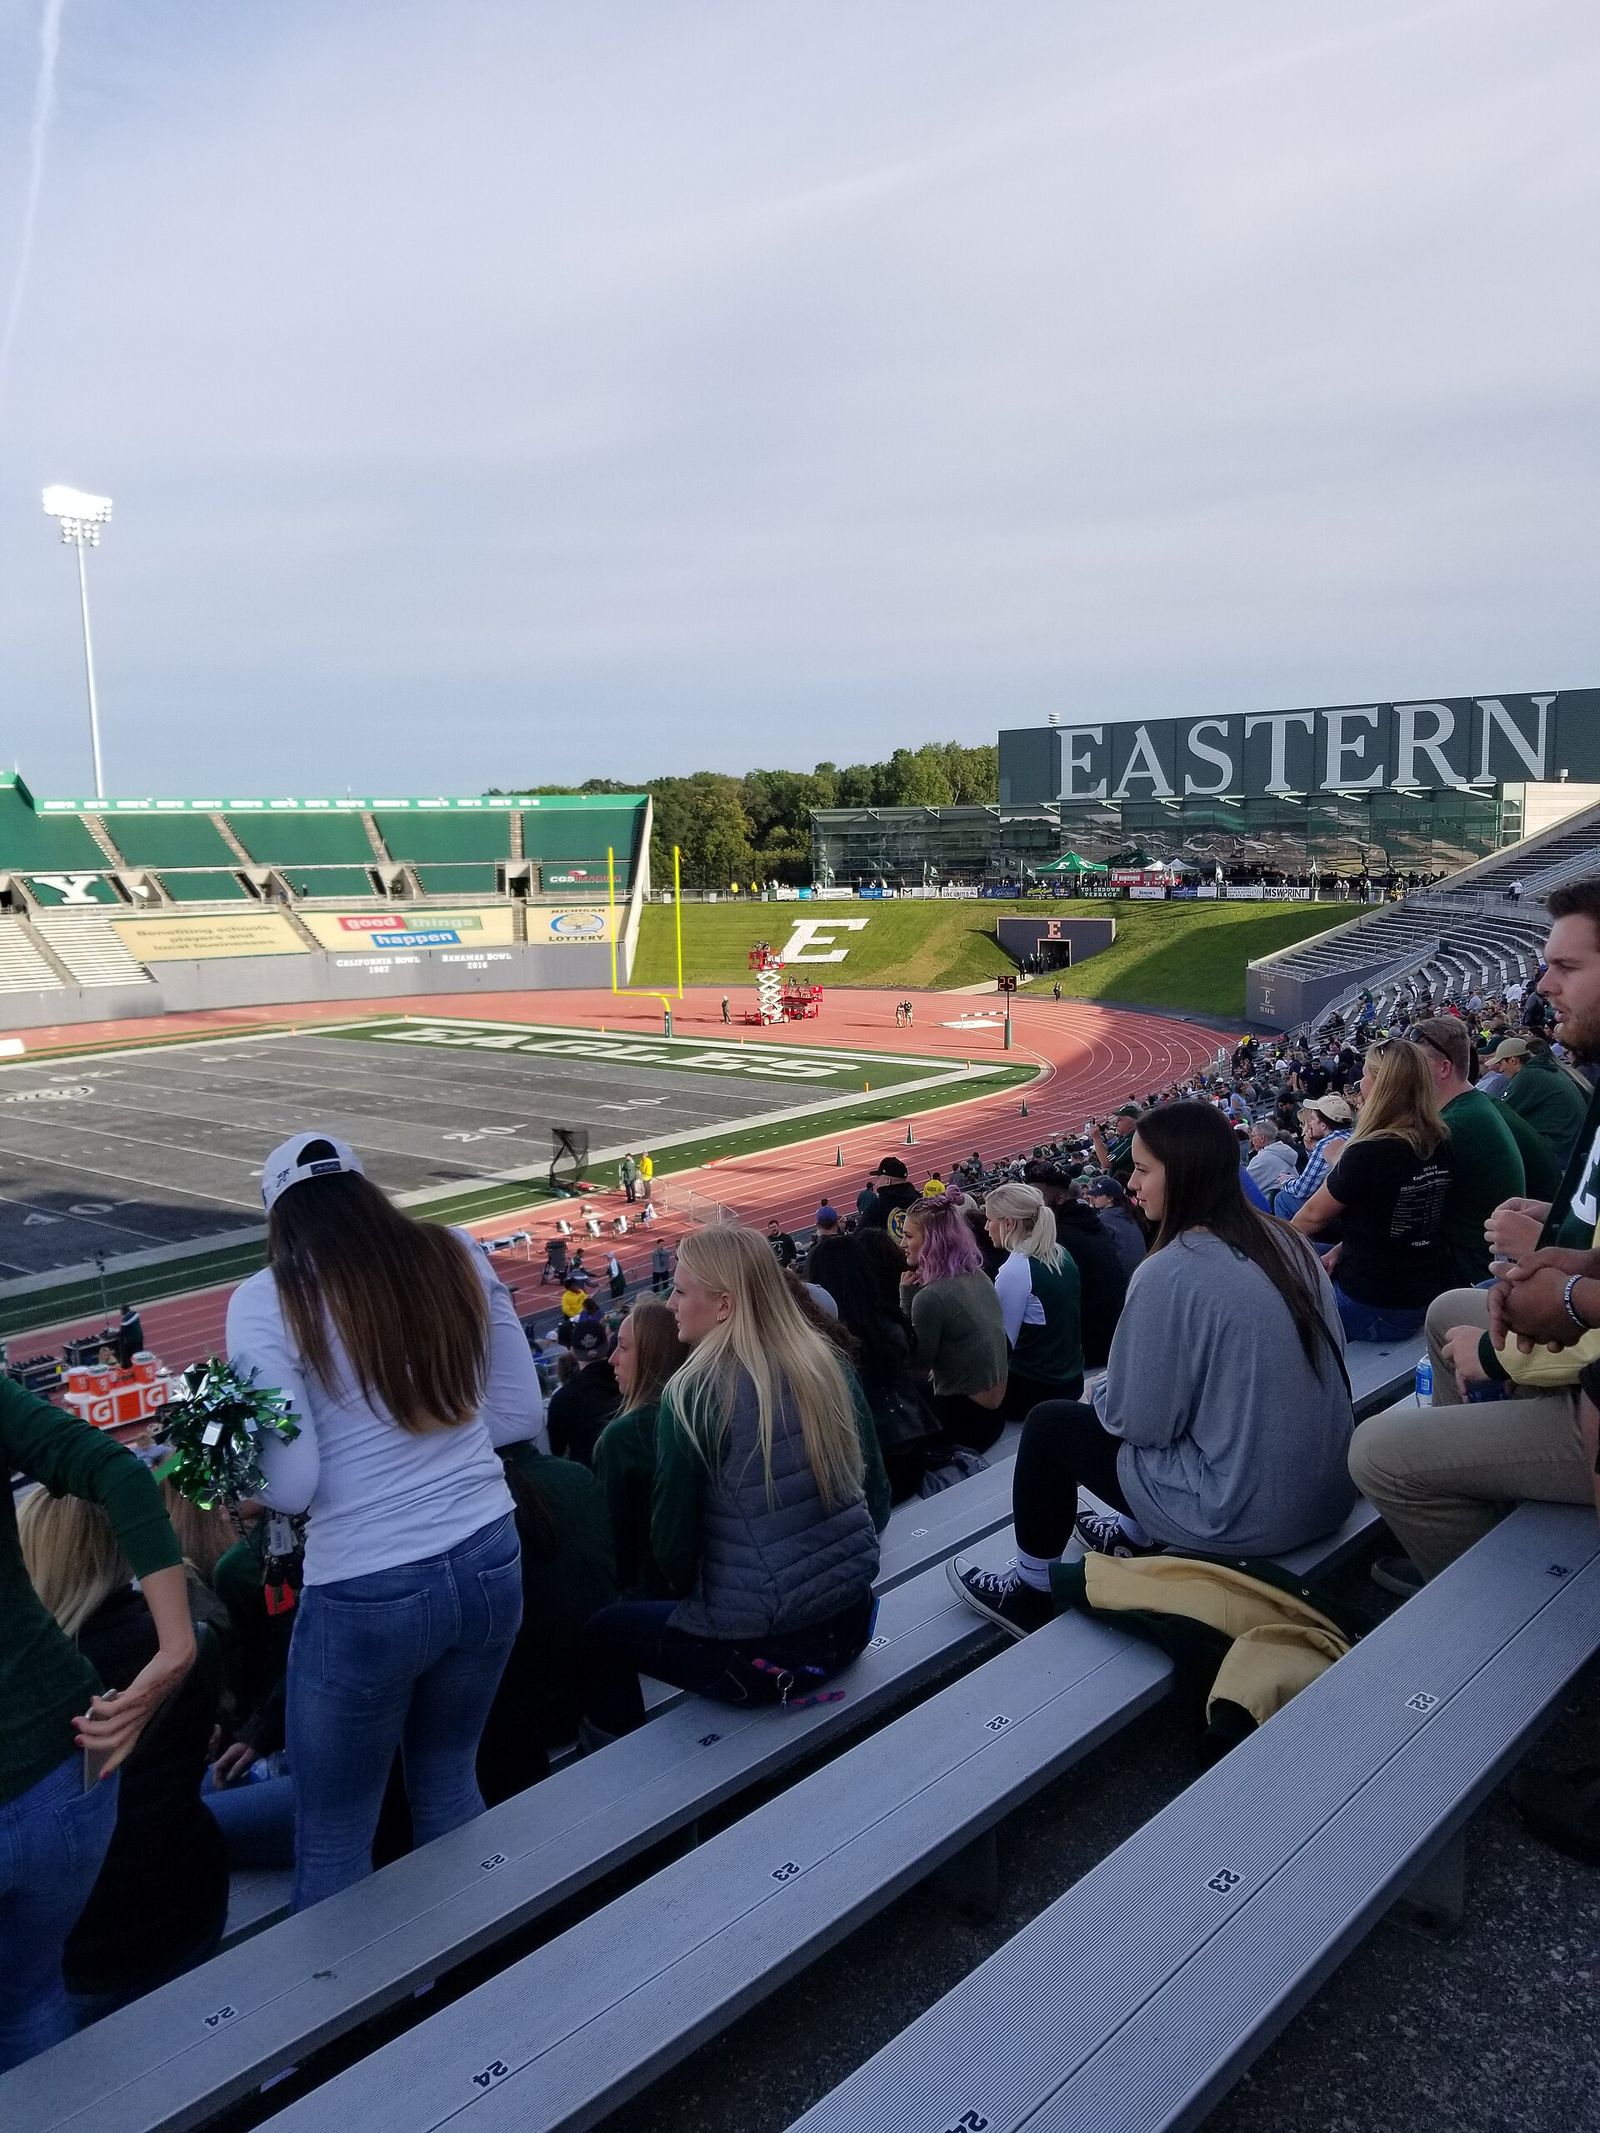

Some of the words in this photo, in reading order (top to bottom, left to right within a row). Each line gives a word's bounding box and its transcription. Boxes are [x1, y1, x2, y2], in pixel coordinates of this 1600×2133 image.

[1056, 696, 1556, 799] EASTERN
[32, 876, 99, 904] Y
[346, 917, 398, 930] good
[411, 916, 473, 929] things
[1047, 921, 1061, 938] E
[136, 928, 213, 937] Benefiting
[169, 935, 222, 944] players
[378, 933, 453, 946] happen
[781, 918, 870, 964] E
[153, 942, 190, 950] local
[336, 957, 392, 967] CALIFORNIA
[395, 956, 421, 964] BOWL
[442, 954, 485, 962] BAHAMAS
[487, 953, 512, 961] BOWL
[999, 977, 1014, 990] 25
[371, 1028, 860, 1078] EAGLES
[596, 1096, 661, 1112] 10
[443, 1125, 518, 1143] 20
[24, 1202, 113, 1225] 40
[146, 1386, 164, 1407] G
[92, 1401, 111, 1422] G
[870, 1637, 887, 1648] 21
[1408, 1692, 1436, 1711] 22
[985, 1715, 1010, 1731] 22
[698, 1733, 720, 1747] 22
[480, 1854, 505, 1870] 23
[771, 1862, 800, 1882] 23
[1208, 1868, 1240, 1894] 23
[204, 2006, 235, 2027] 24
[472, 2061, 508, 2087] 24
